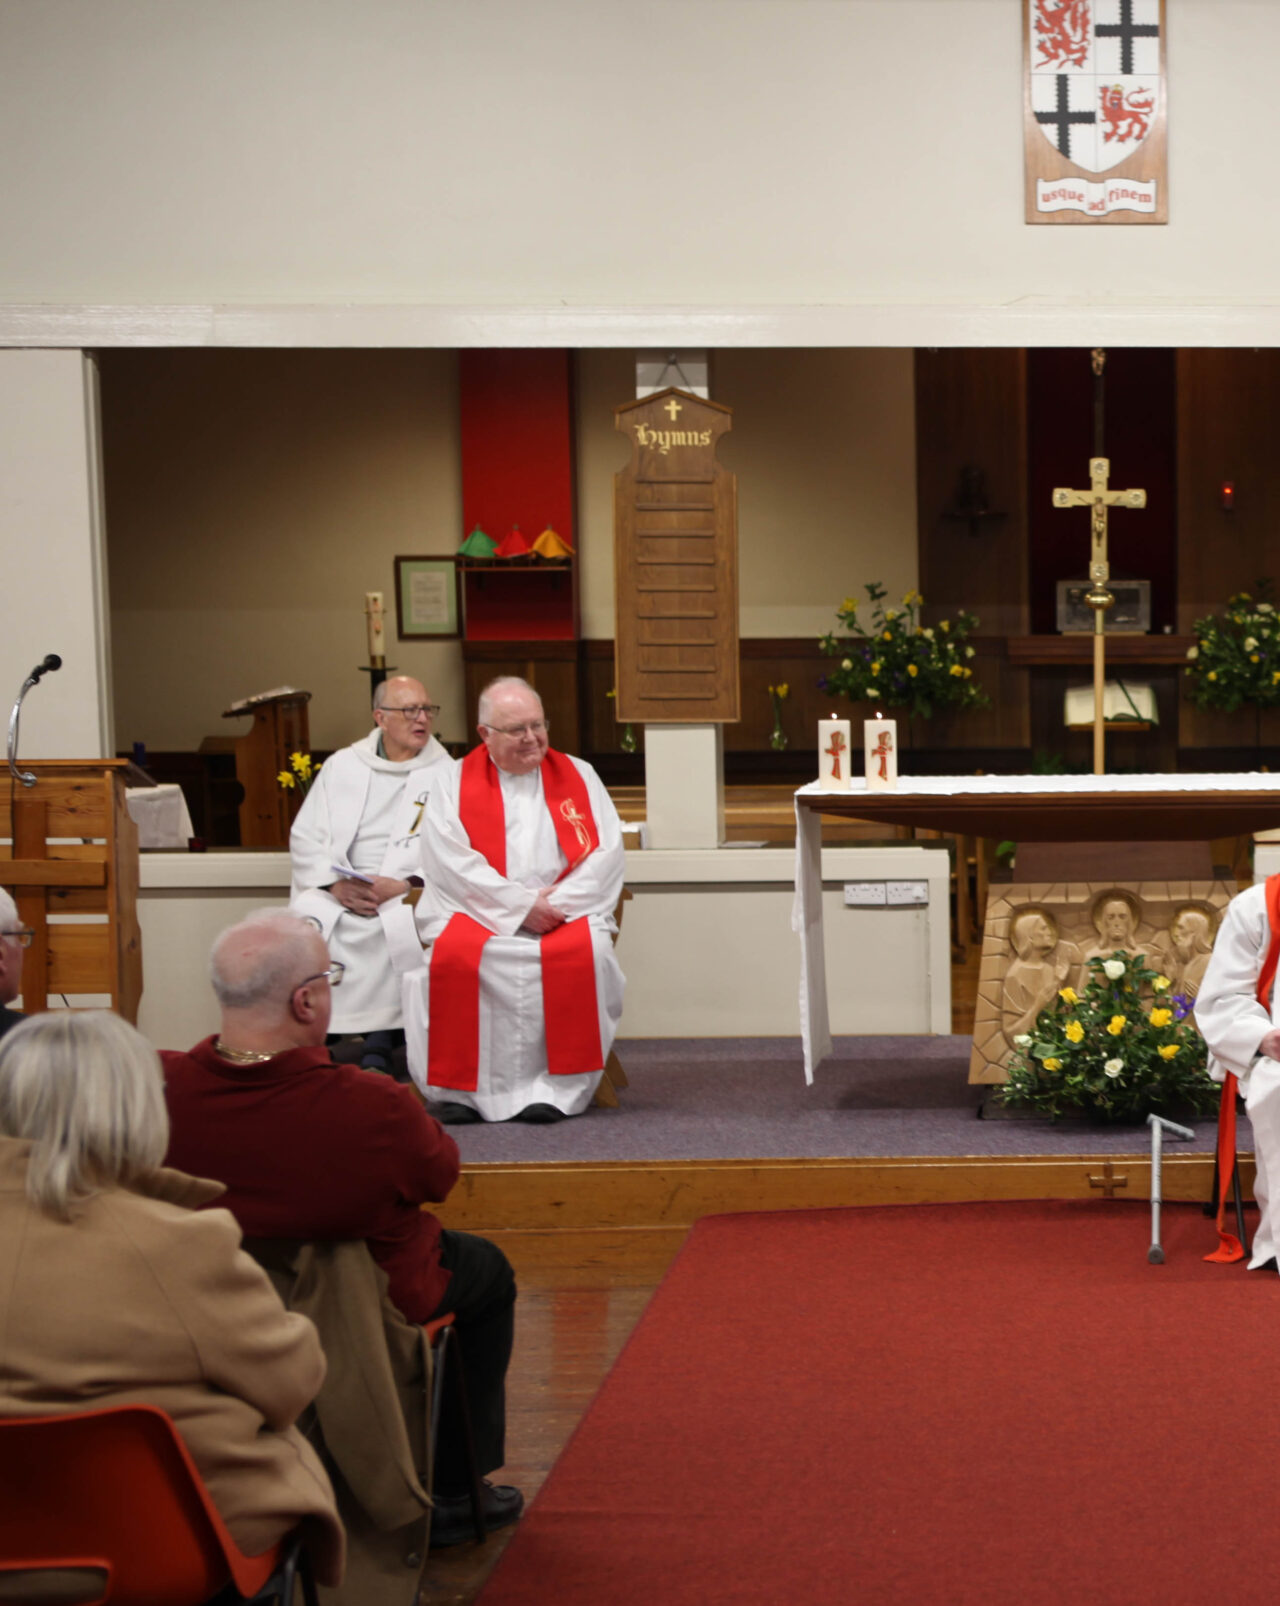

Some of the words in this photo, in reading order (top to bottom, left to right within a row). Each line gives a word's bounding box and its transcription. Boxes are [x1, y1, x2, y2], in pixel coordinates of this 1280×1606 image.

[1041, 188, 1085, 203] usque
[1088, 198, 1106, 211] ad
[634, 422, 712, 455] Hymns
